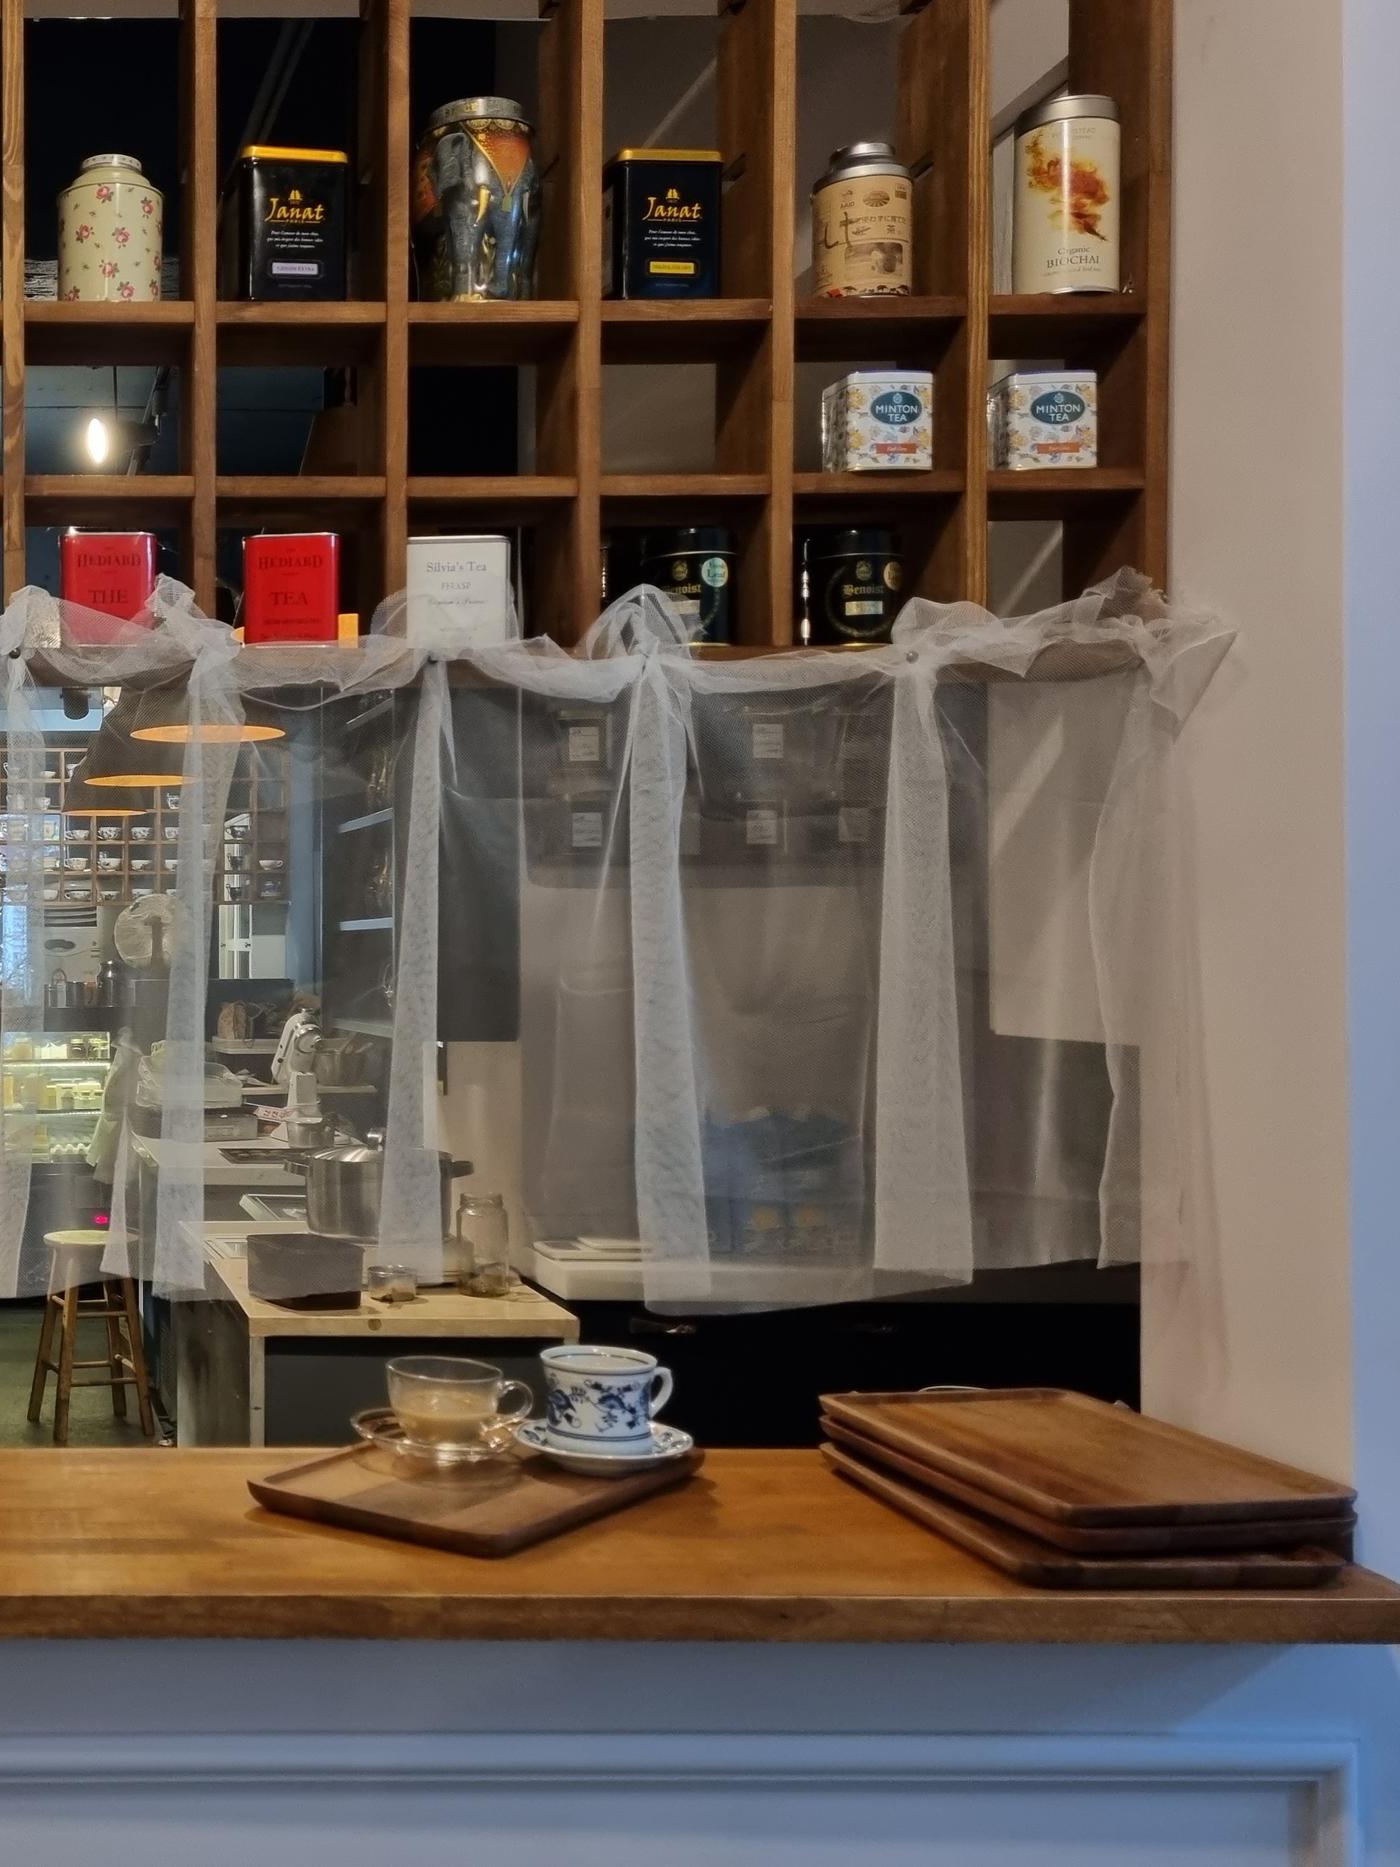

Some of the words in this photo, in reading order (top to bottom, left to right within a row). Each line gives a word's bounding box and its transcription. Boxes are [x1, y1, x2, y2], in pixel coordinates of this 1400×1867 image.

[264, 198, 324, 222] Janat
[642, 196, 702, 221] Janat
[875, 404, 919, 414] MINTON
[1036, 403, 1081, 414] MINTON
[887, 413, 908, 423] TEA
[1049, 413, 1070, 422] TEA
[258, 555, 323, 570] HEDIARD
[426, 561, 464, 573] Silvia's
[466, 561, 487, 572] Tea
[269, 592, 309, 606] TEA
